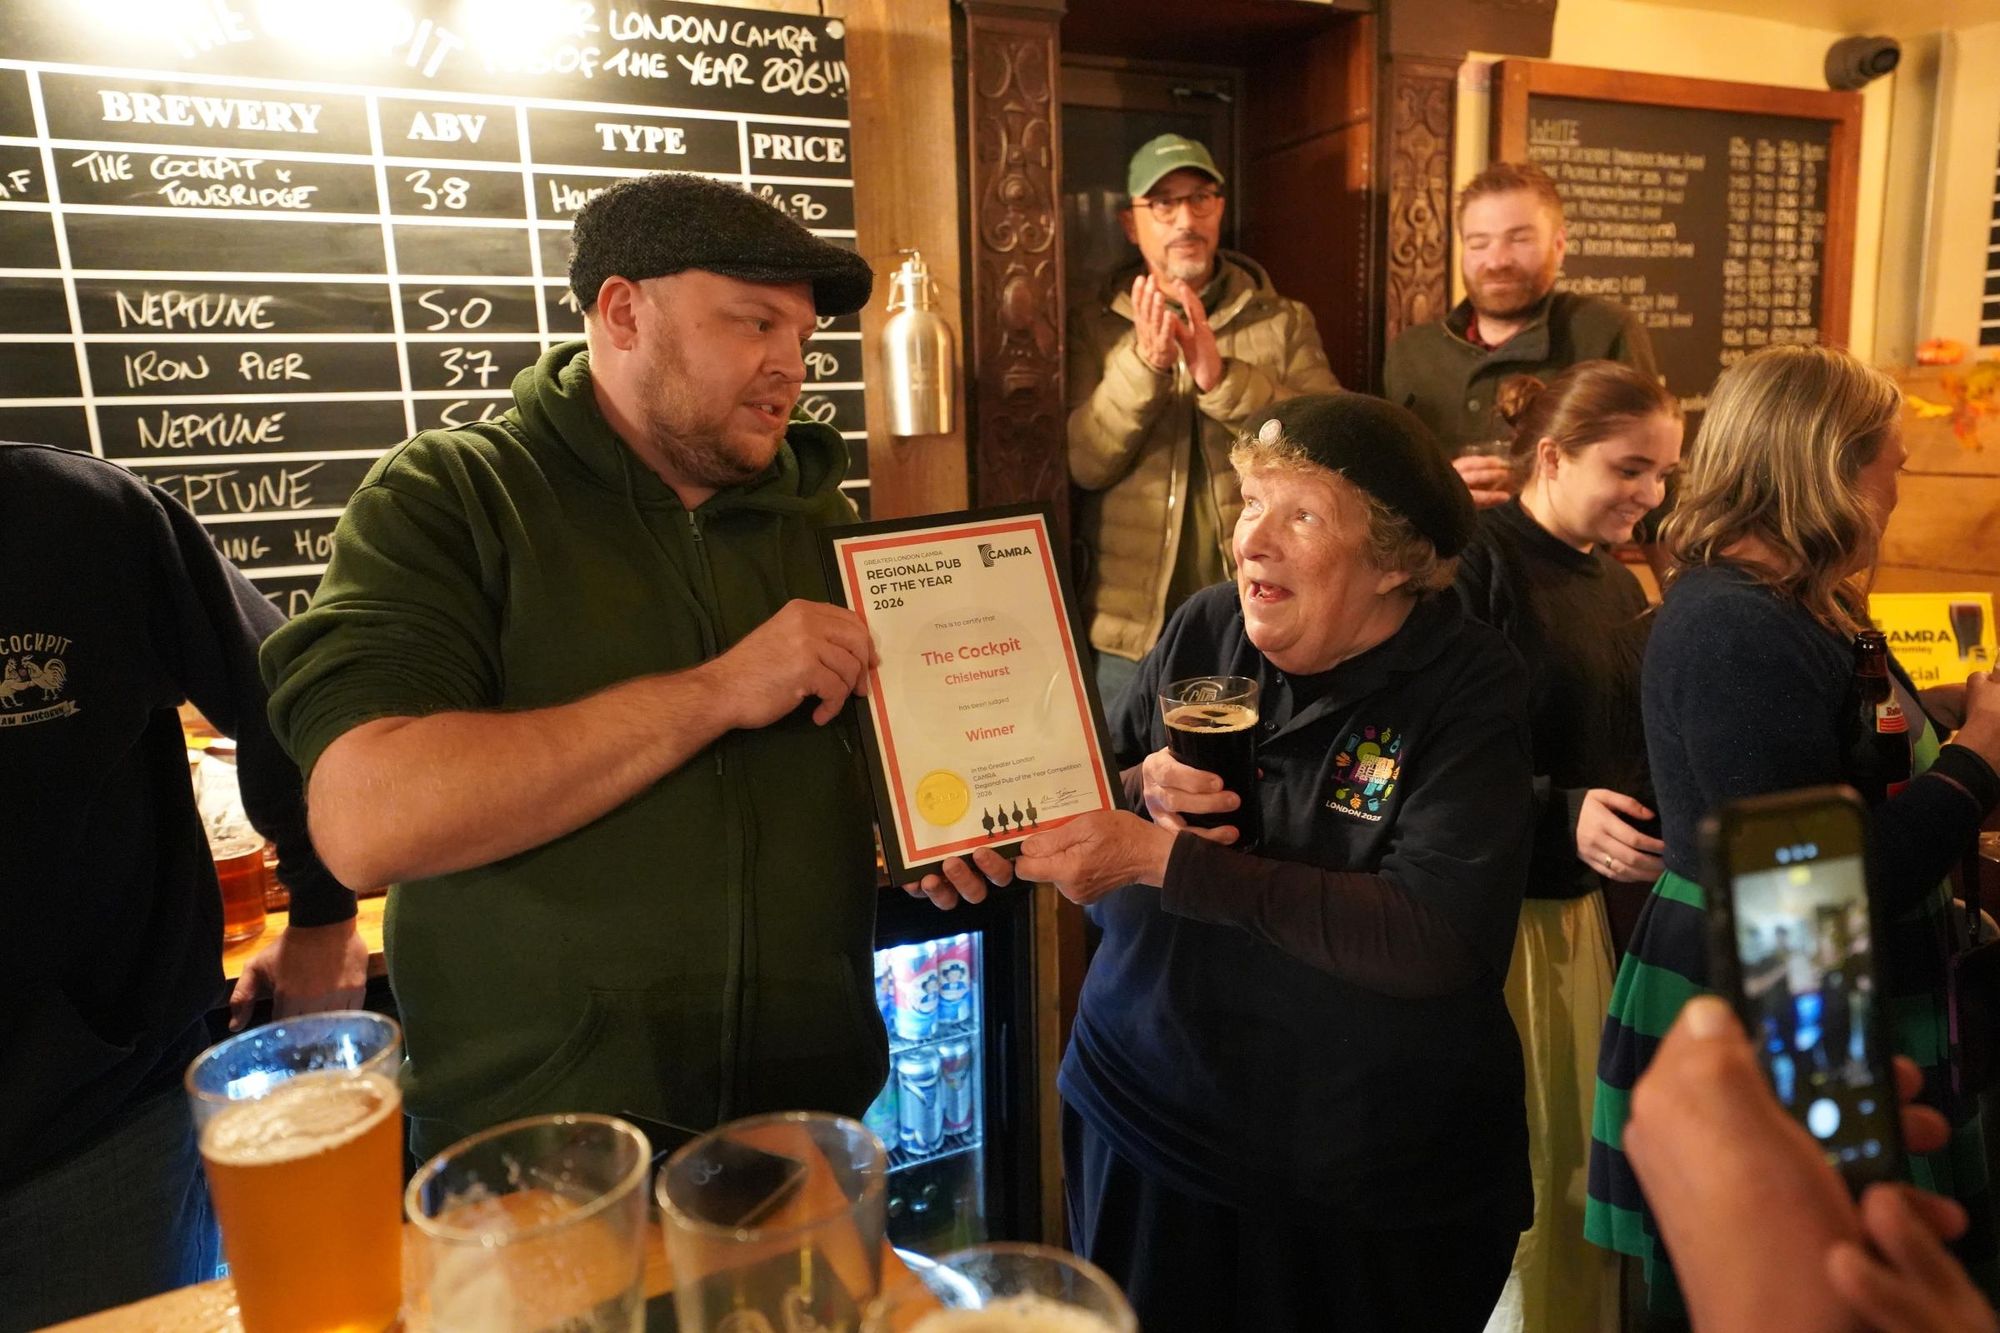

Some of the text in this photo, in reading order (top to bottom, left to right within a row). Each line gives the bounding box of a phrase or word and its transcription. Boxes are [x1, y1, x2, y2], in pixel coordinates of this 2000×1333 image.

[609, 9, 727, 45] LONDON
[731, 21, 817, 56] CAMRA
[603, 49, 668, 80] THE
[677, 52, 754, 88] YEAR
[98, 90, 322, 135] BREWERY
[407, 110, 487, 144] ABV
[595, 122, 687, 155] TYPE
[751, 133, 847, 164] PRICE
[73, 151, 135, 184] THE
[150, 155, 265, 181] COCKPIT
[158, 180, 319, 209] TONBRIDGE
[405, 169, 470, 211] 3.8
[115, 290, 275, 330] NEPTUNE
[418, 289, 492, 331] 5.0
[125, 350, 312, 388] IRON PIER
[439, 347, 500, 388] 3.7
[138, 410, 287, 450] NEPTUNE
[148, 461, 326, 514] EPTUNE
[864, 550, 943, 566] GREATER LONDON CAMRA
[989, 546, 1032, 560] CAMRA
[867, 558, 961, 580] REGIONAL PUB
[870, 575, 952, 595] OF THE YEAR
[874, 598, 904, 610] 2026
[935, 622, 947, 630] This
[962, 617, 981, 626] certify
[982, 615, 996, 623] that
[1888, 630, 1951, 643] AMRA
[0, 633, 72, 655] COCKPIT
[921, 637, 1022, 666] The Cockpit
[945, 666, 1010, 685] Chislehurst
[966, 724, 1015, 742] Winner
[973, 773, 996, 781] CAMRA
[988, 761, 1011, 770] Greater
[1012, 756, 1035, 765] London
[1326, 800, 1361, 817] LONDON
